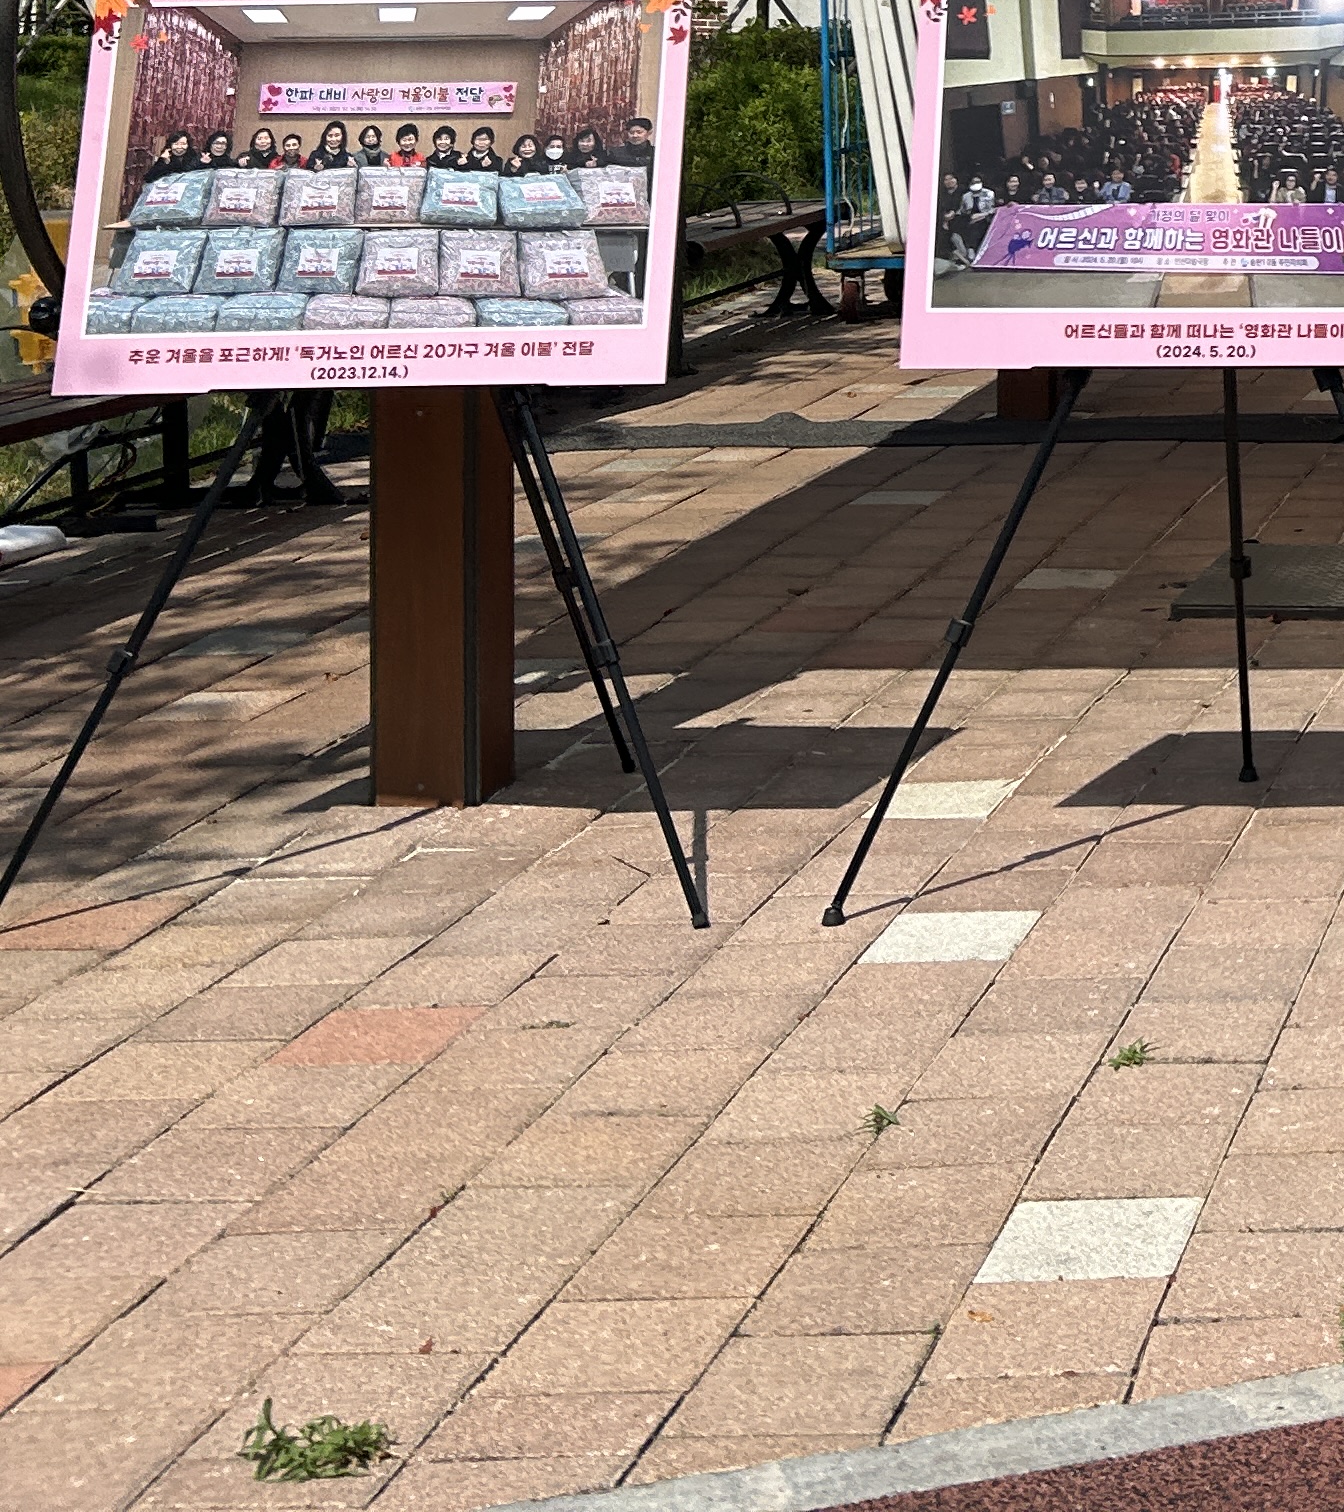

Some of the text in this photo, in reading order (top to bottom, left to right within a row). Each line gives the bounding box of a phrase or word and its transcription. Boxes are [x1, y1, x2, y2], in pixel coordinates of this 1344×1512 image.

[285, 87, 314, 103] 한파
[319, 87, 346, 101] 대비
[351, 87, 393, 103] 사랑의
[455, 86, 484, 102] 전달
[1036, 227, 1344, 253] 어르신과 함께하는 영화관 나들이
[1064, 324, 1146, 340] 어르신들과
[1150, 324, 1182, 339] 함께
[1186, 324, 1235, 339] 떠나는
[128, 349, 161, 365] 추운
[165, 348, 214, 365] 겨울을
[218, 346, 290, 364] 포근하게!
[370, 344, 419, 360] 어르신
[423, 343, 480, 361] 20가구
[484, 342, 516, 359] 겨울
[562, 341, 595, 357] 전달
[310, 365, 410, 381] (2023.12.14.)
